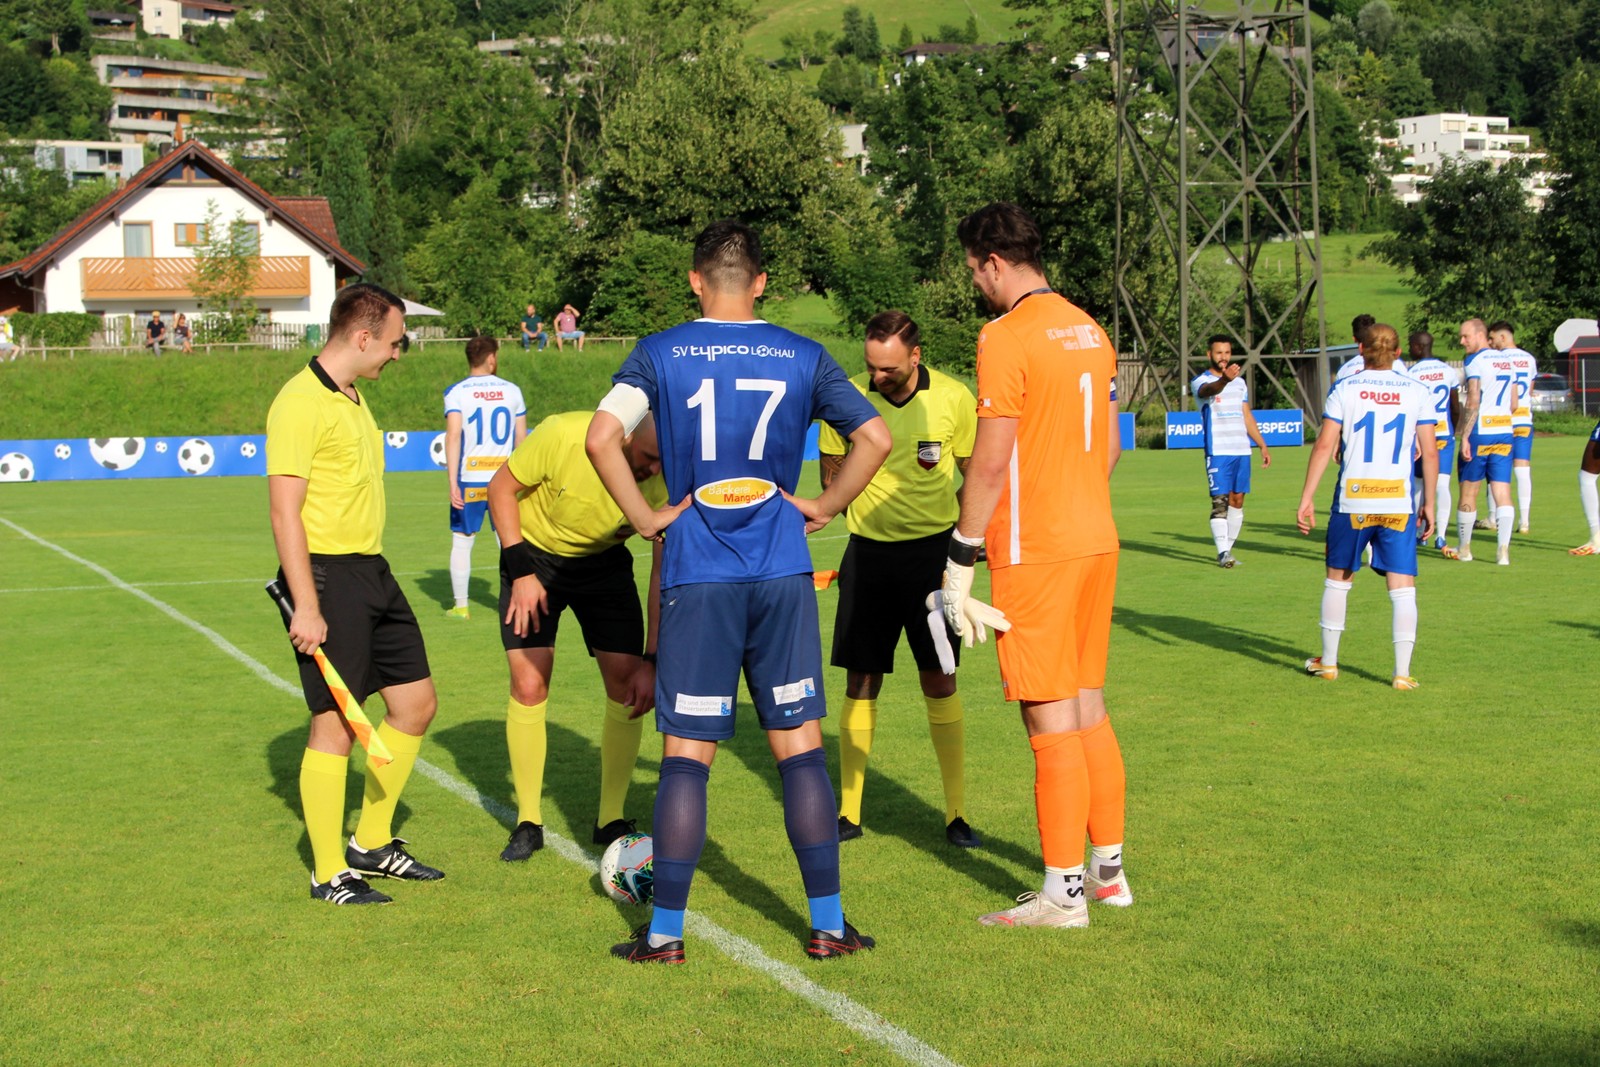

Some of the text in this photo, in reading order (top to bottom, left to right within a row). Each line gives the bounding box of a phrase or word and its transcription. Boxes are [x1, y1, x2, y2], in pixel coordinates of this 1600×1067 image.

[672, 346, 688, 358] SV
[690, 345, 749, 361] typico
[1419, 372, 1444, 382] ORION
[473, 391, 504, 401] ORION
[1359, 391, 1401, 405] ORION
[1495, 375, 1511, 406] 7
[686, 378, 787, 461] 17
[1079, 372, 1092, 452] 1
[468, 406, 511, 446] 10
[1168, 421, 1301, 436] FAIRP ESPECT
[1353, 410, 1406, 464] 11
[707, 483, 751, 495] Bäckerei
[723, 491, 767, 504] Mangold
